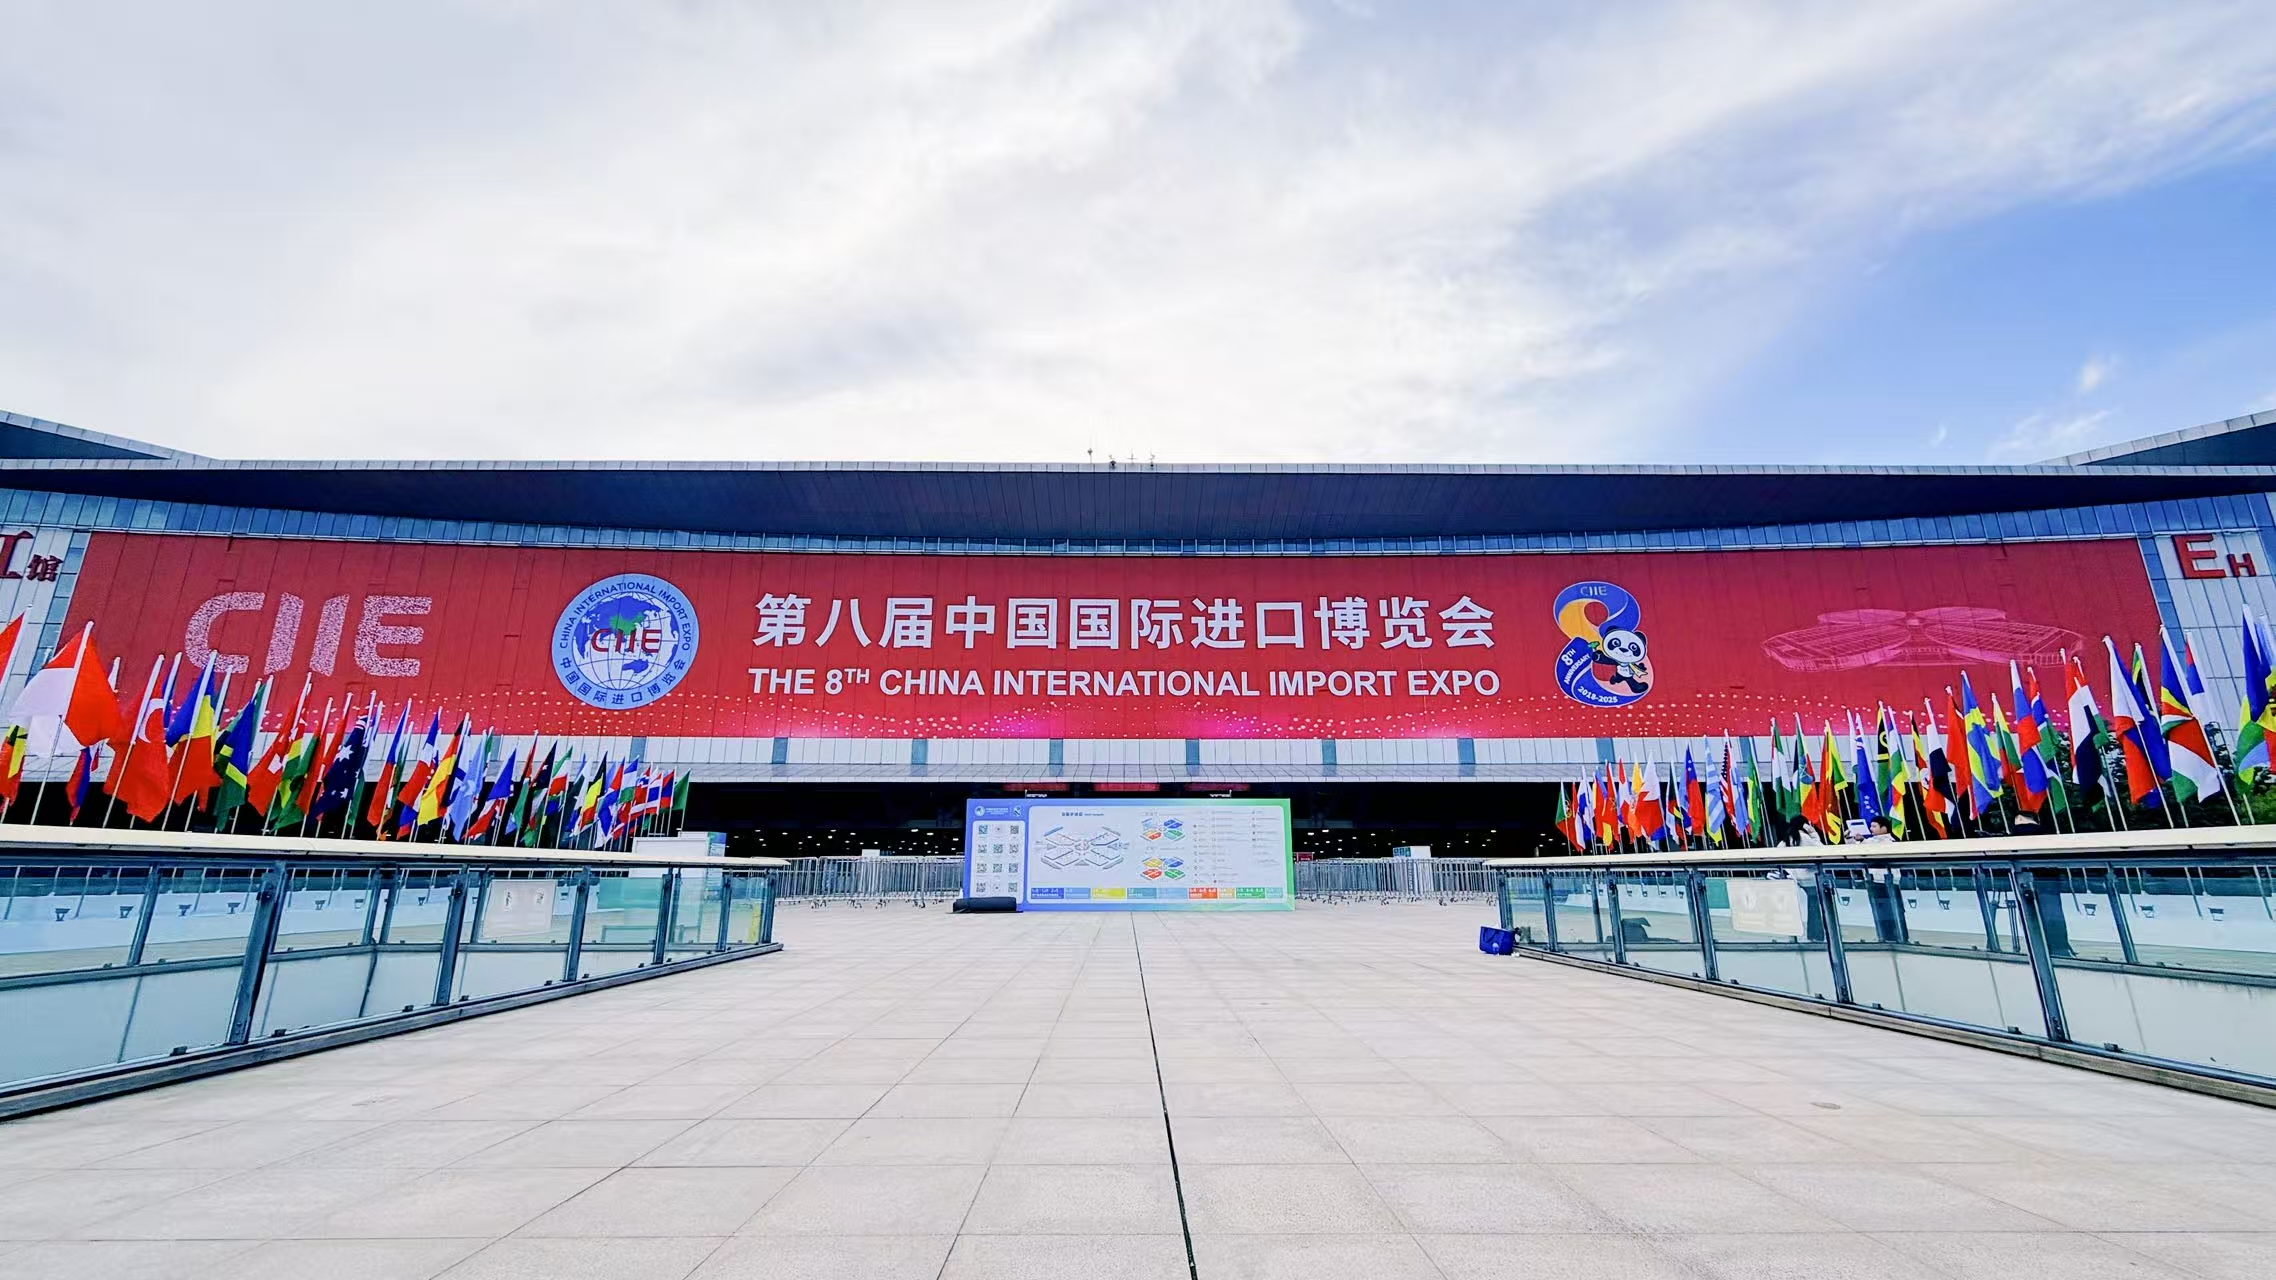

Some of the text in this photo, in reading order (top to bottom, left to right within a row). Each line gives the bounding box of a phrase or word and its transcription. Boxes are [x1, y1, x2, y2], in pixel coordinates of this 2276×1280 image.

[1580, 586, 1607, 596] CIIE
[560, 582, 692, 651] CHINA INTERNATIONAL IMPORT EXPO
[752, 593, 1495, 649] 第八届中国国际进口博览会
[185, 592, 432, 677] CIIE
[591, 628, 662, 653] CIIE
[1561, 648, 1576, 666] 8TH
[1563, 653, 1591, 685] ANNIVERSARY
[560, 657, 686, 705] 中国国际进口博览会
[748, 668, 1500, 697] THE 8TH CHINA INTERNATIONAL IMPORT EXPO
[1577, 686, 1619, 704] 2018-2025
